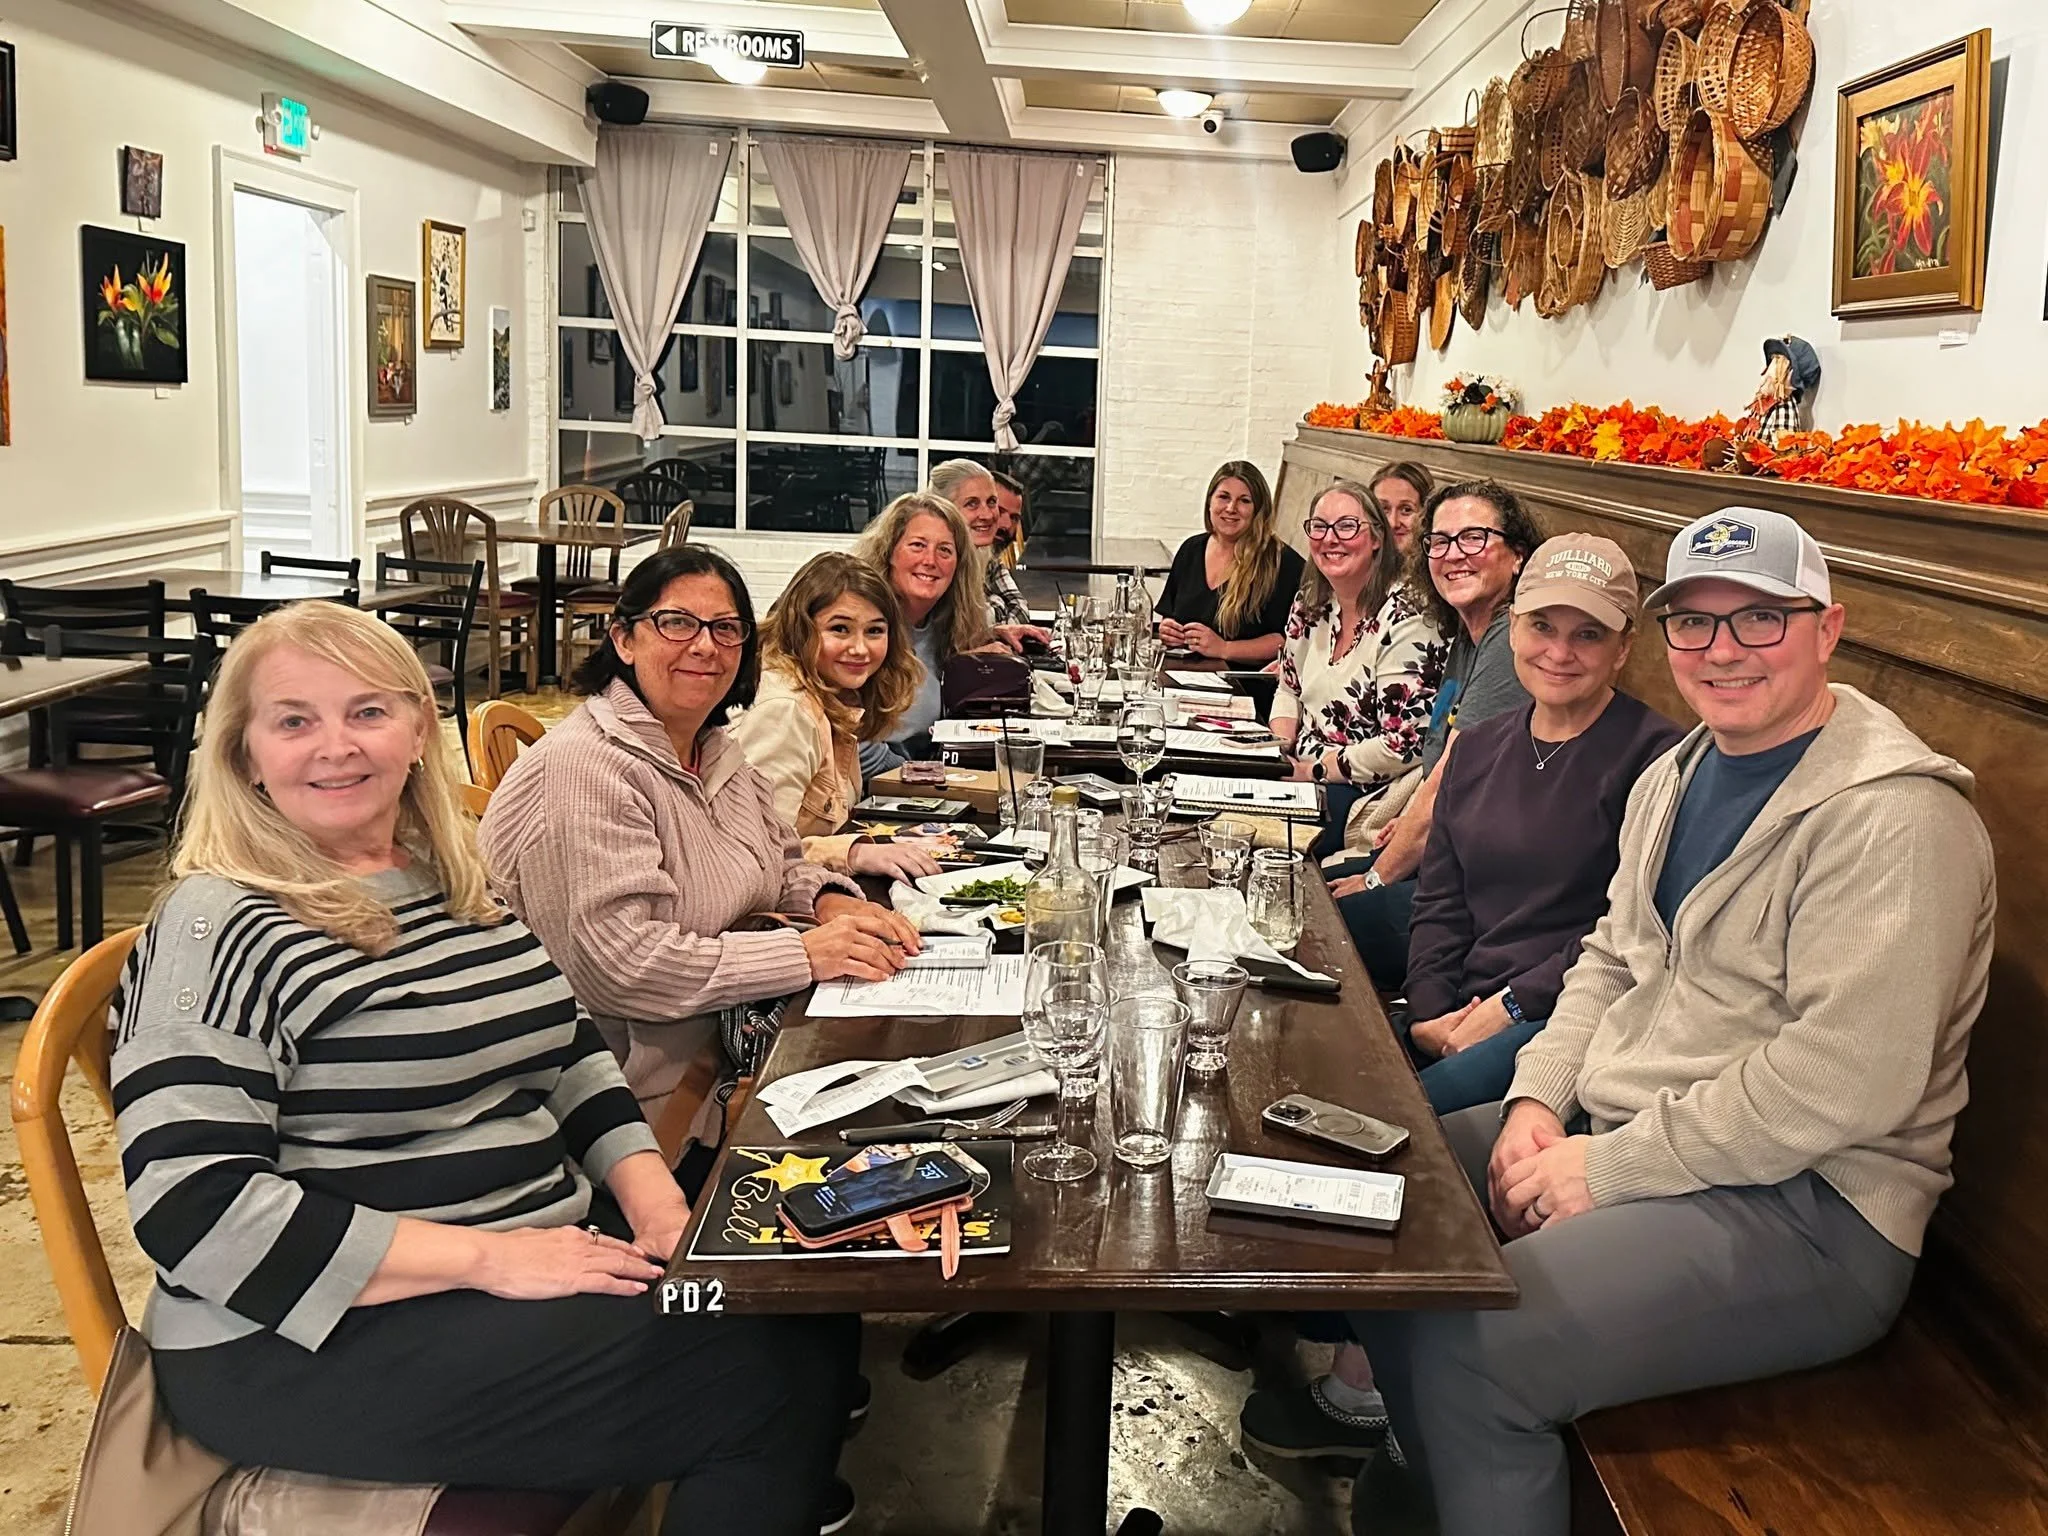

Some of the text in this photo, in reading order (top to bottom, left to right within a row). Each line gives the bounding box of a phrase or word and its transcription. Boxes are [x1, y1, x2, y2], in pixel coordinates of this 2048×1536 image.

[1545, 549, 1612, 577] JUILLIARD
[1545, 570, 1608, 588] NEW YORK CITY
